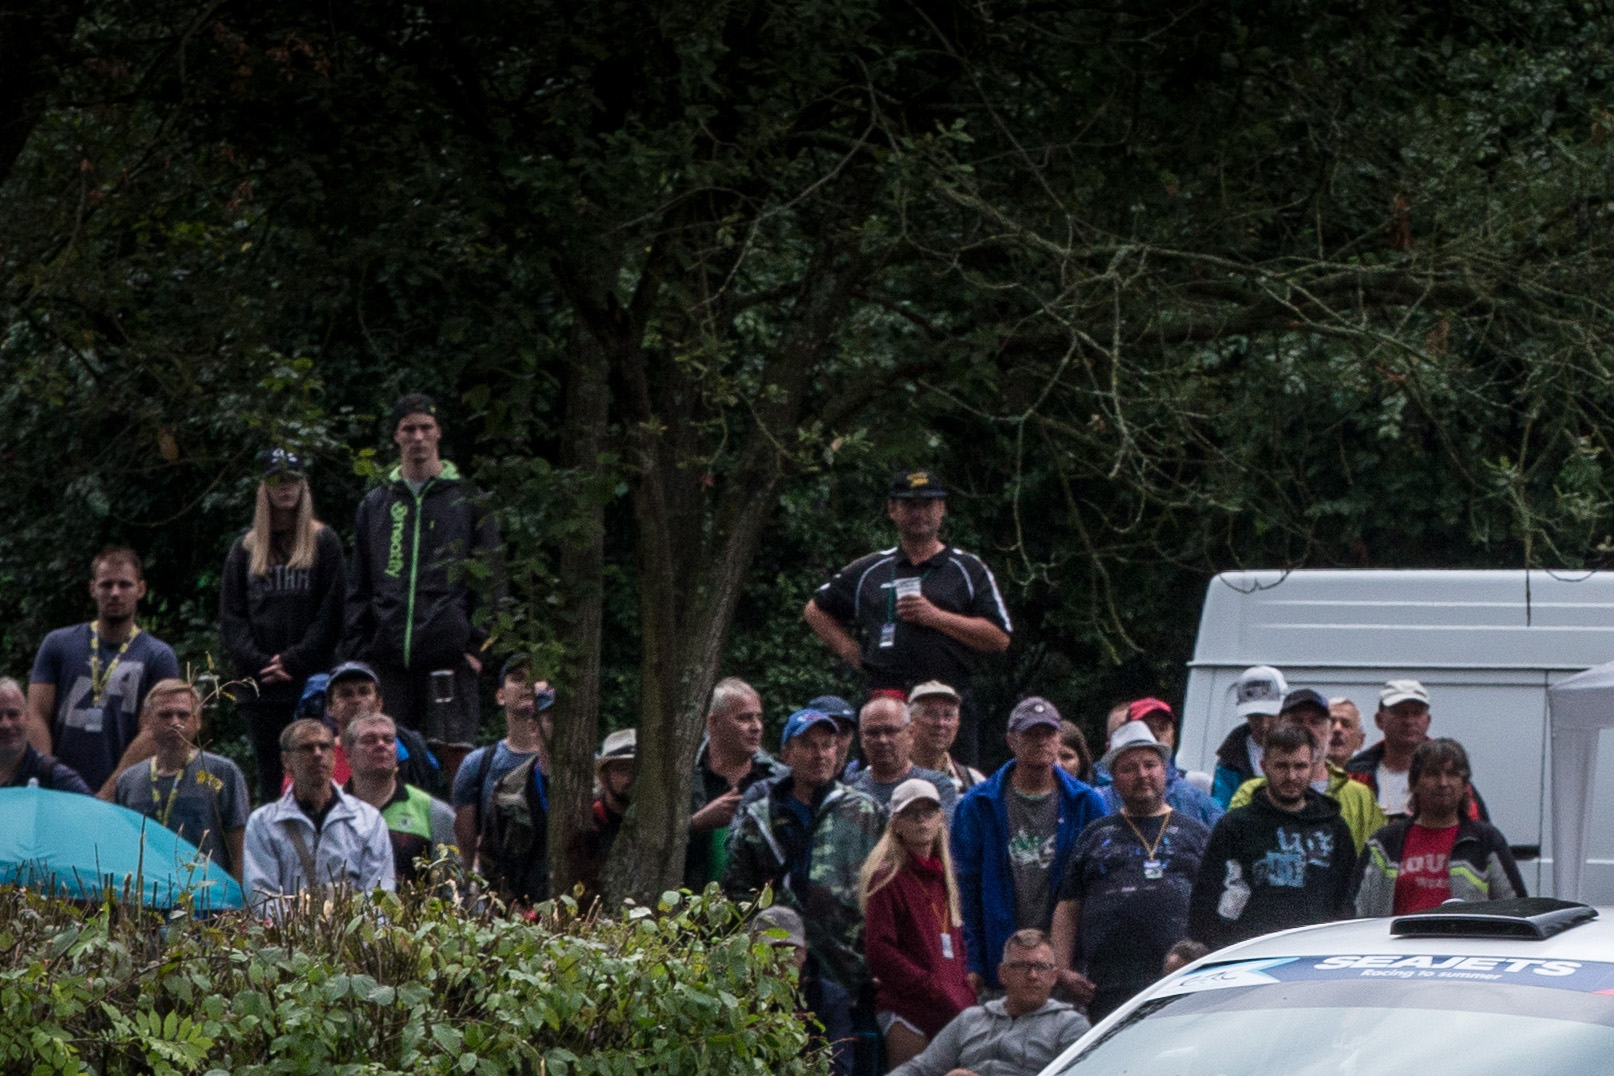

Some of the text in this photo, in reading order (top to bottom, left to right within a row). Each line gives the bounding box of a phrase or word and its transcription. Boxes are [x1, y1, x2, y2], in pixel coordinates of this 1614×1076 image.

[1313, 955, 1583, 977] SEAJETS
[1359, 968, 1503, 982] Racing to summer
